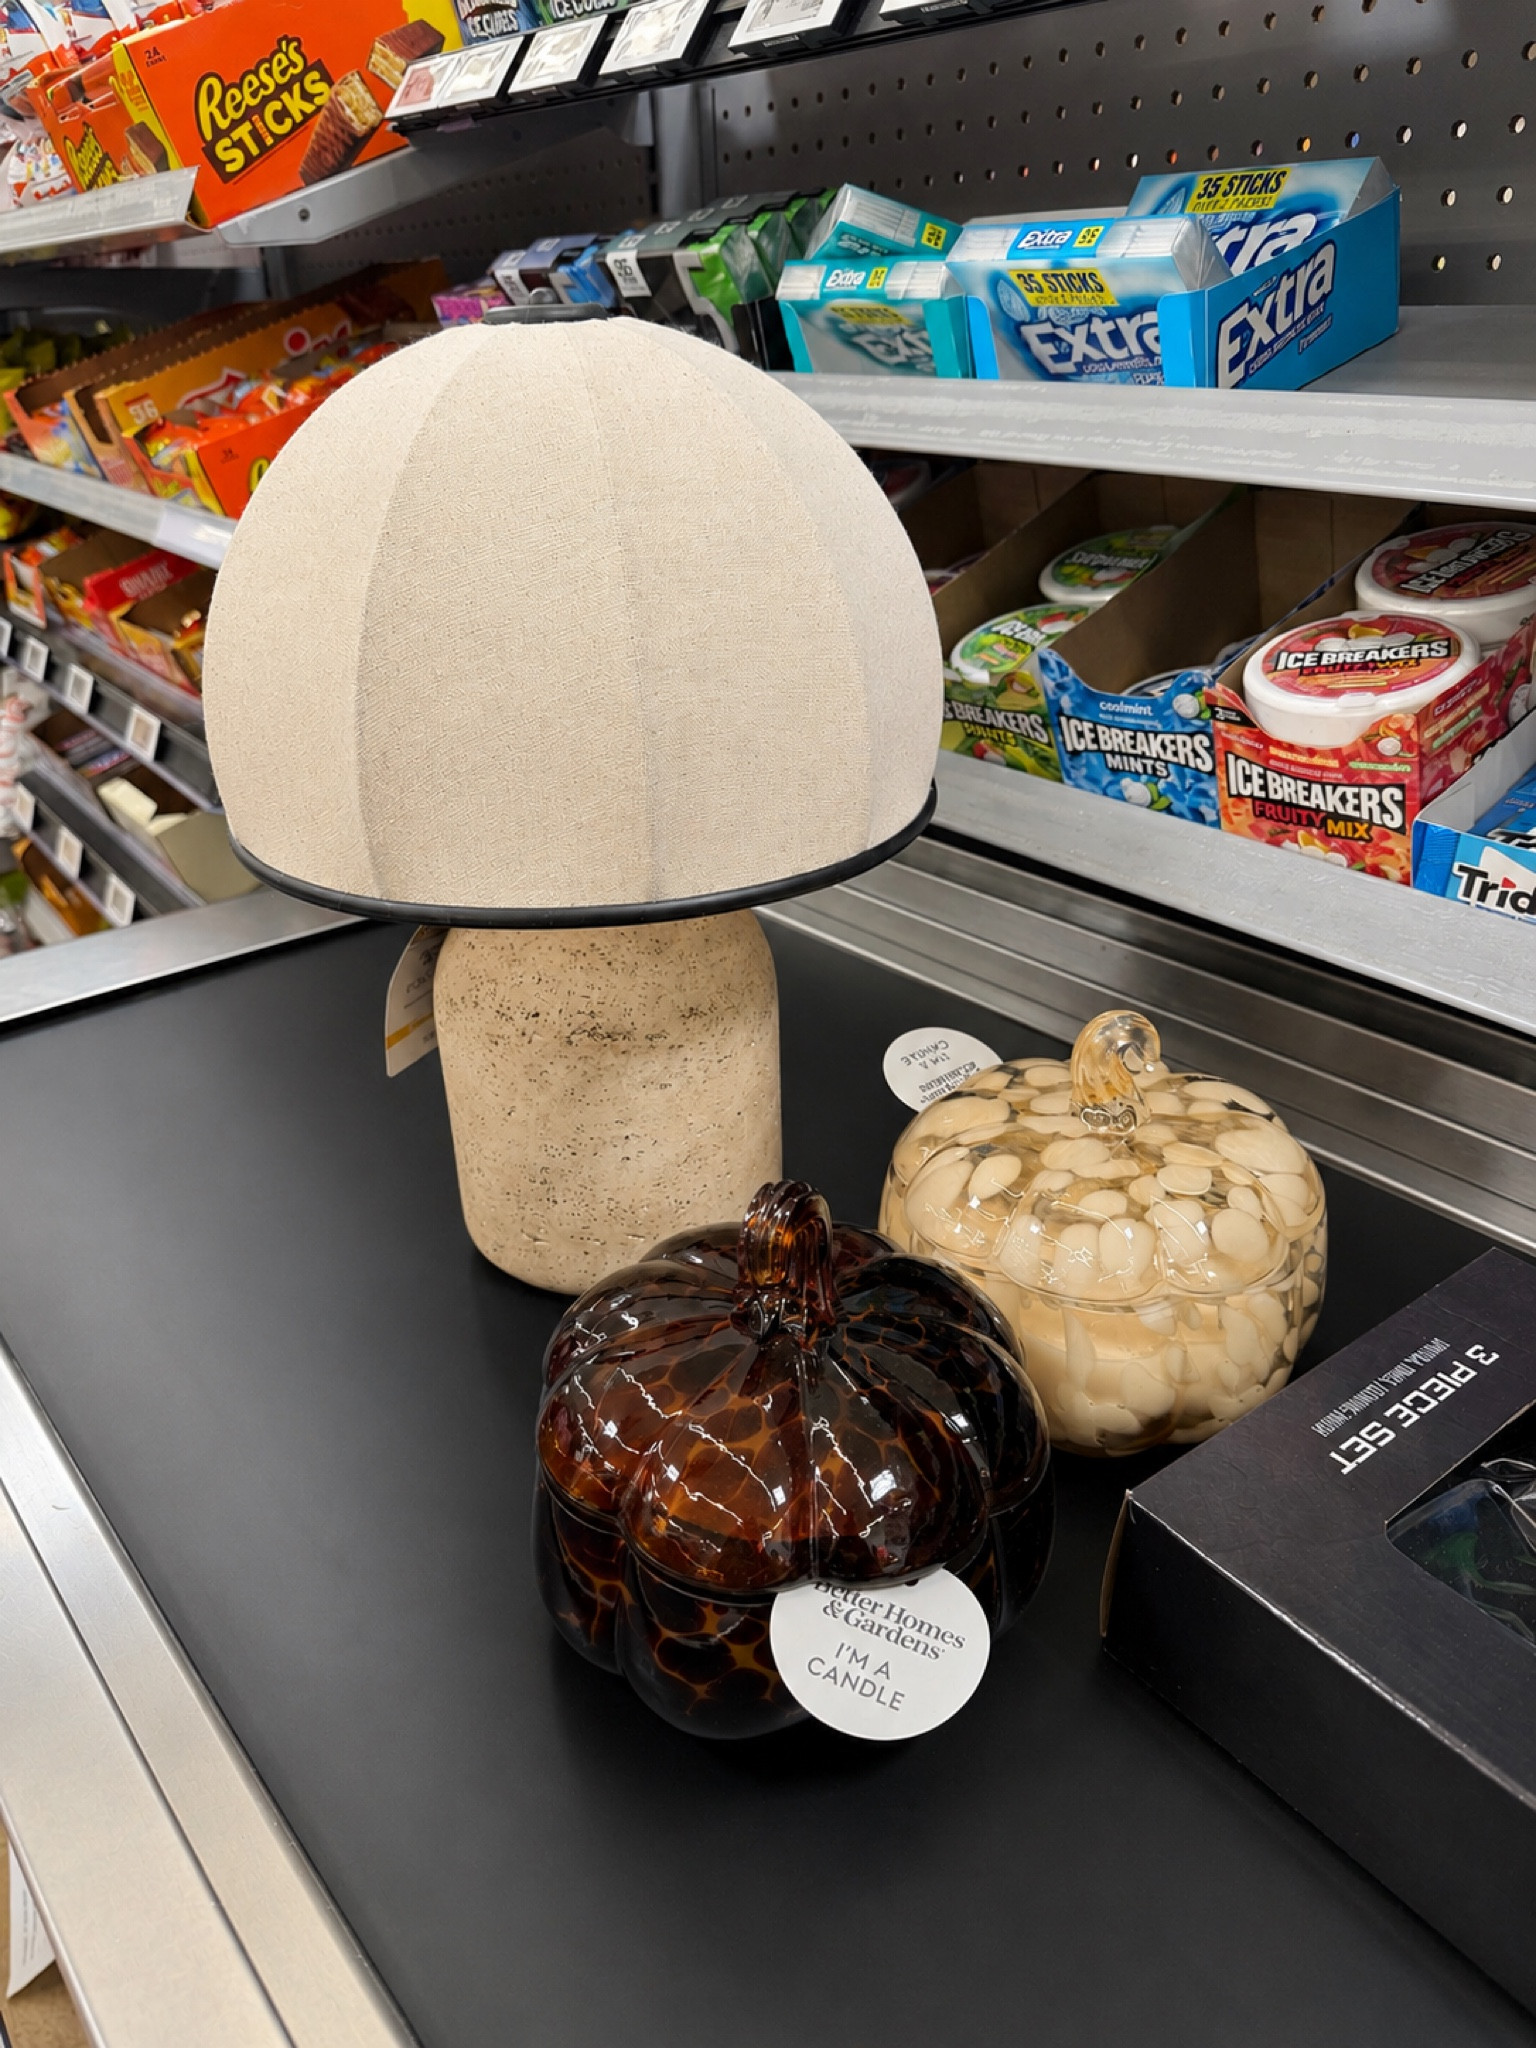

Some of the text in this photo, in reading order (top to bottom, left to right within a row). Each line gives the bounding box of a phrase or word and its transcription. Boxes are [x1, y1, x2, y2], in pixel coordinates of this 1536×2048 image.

[199, 40, 304, 141] Reese's
[215, 71, 331, 173] STICKS
[1197, 170, 1287, 199] 35 STICKS
[1018, 230, 1073, 248] Extra
[1016, 271, 1104, 293] 35 STICKS
[1220, 242, 1336, 388] Extra
[1277, 640, 1449, 670] ICE BREAKERS
[955, 702, 1049, 743] BREAKERS
[1060, 717, 1099, 752] ICE
[1102, 726, 1214, 773] BREAKERS
[1106, 753, 1168, 778] MINTS
[1227, 753, 1267, 797] ICE
[1266, 770, 1404, 828] BREAKERS
[1255, 802, 1371, 840] FRUITY MIX
[1465, 1344, 1500, 1366] 3
[1383, 1361, 1478, 1428] PIECE
[1329, 1421, 1396, 1475] SET
[843, 1607, 940, 1660] Gardens
[883, 1601, 966, 1650] Homes
[807, 1657, 905, 1711] CANDLE
[835, 1642, 890, 1680] I'M A
